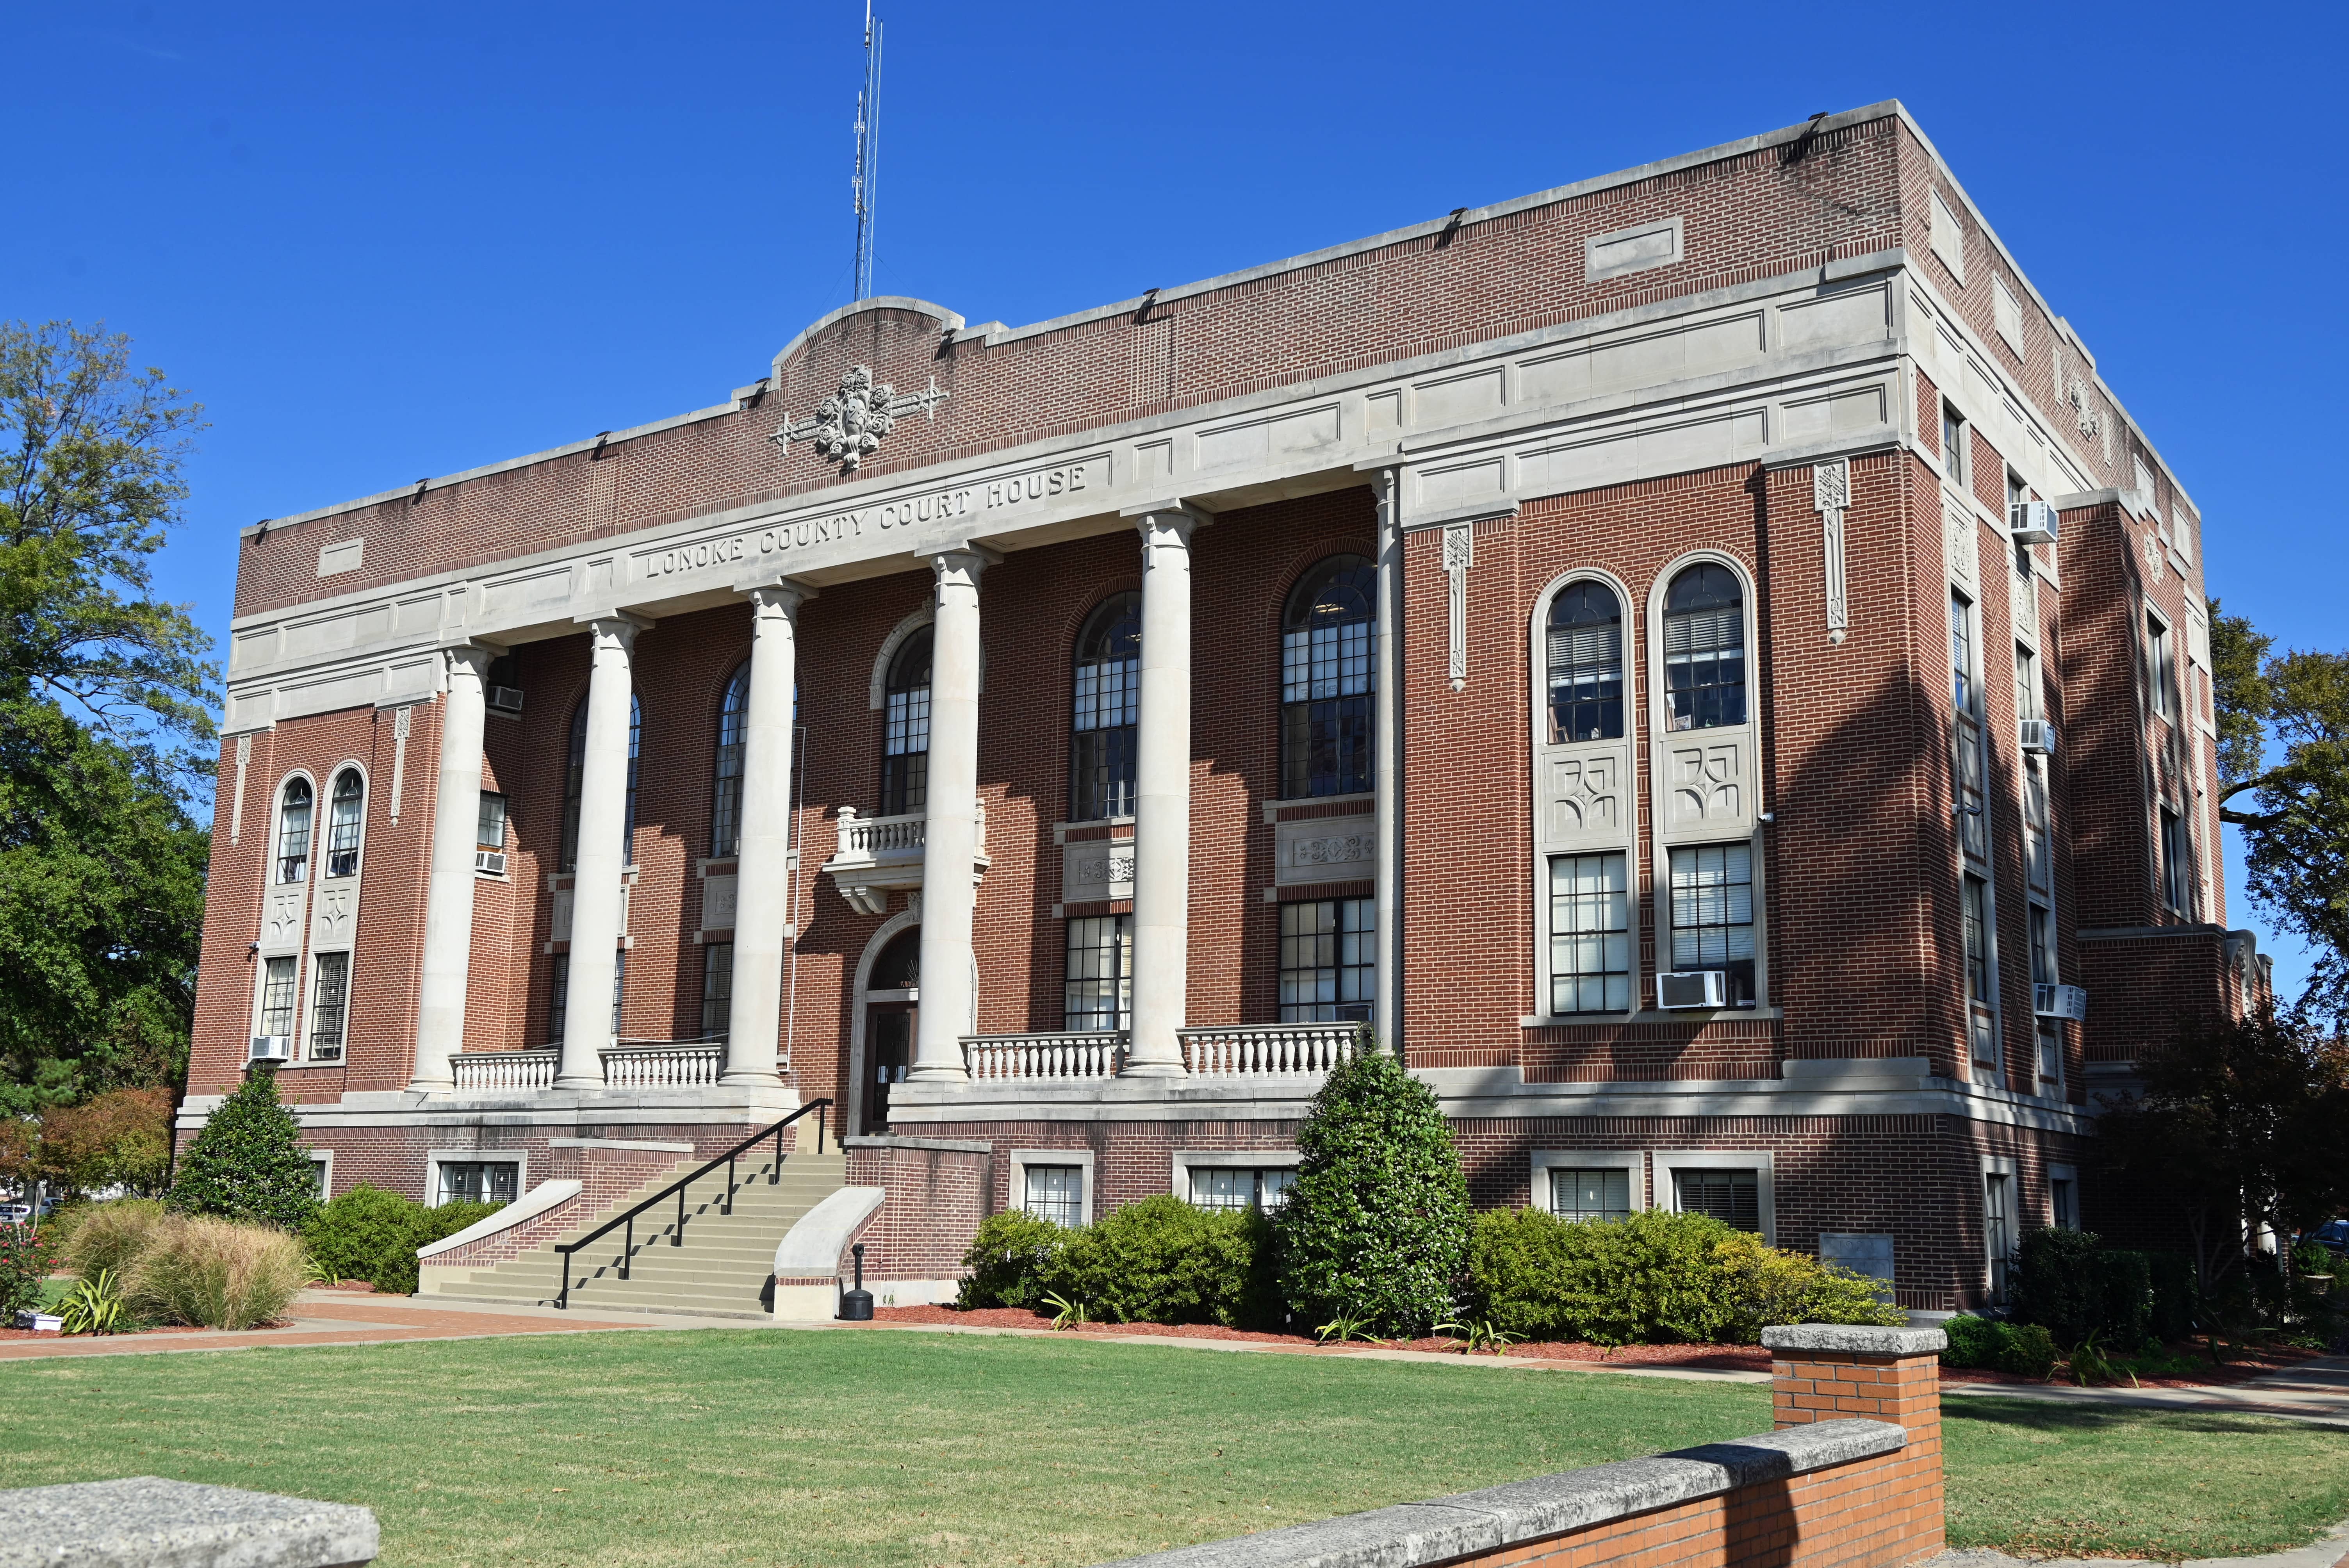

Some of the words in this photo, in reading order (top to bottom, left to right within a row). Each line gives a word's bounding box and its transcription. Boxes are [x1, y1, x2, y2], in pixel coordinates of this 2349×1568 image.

[647, 536, 743, 578] LONOKE
[761, 510, 868, 554] COUNTY
[880, 488, 971, 530] COURT
[987, 463, 1086, 509] HOUSE
